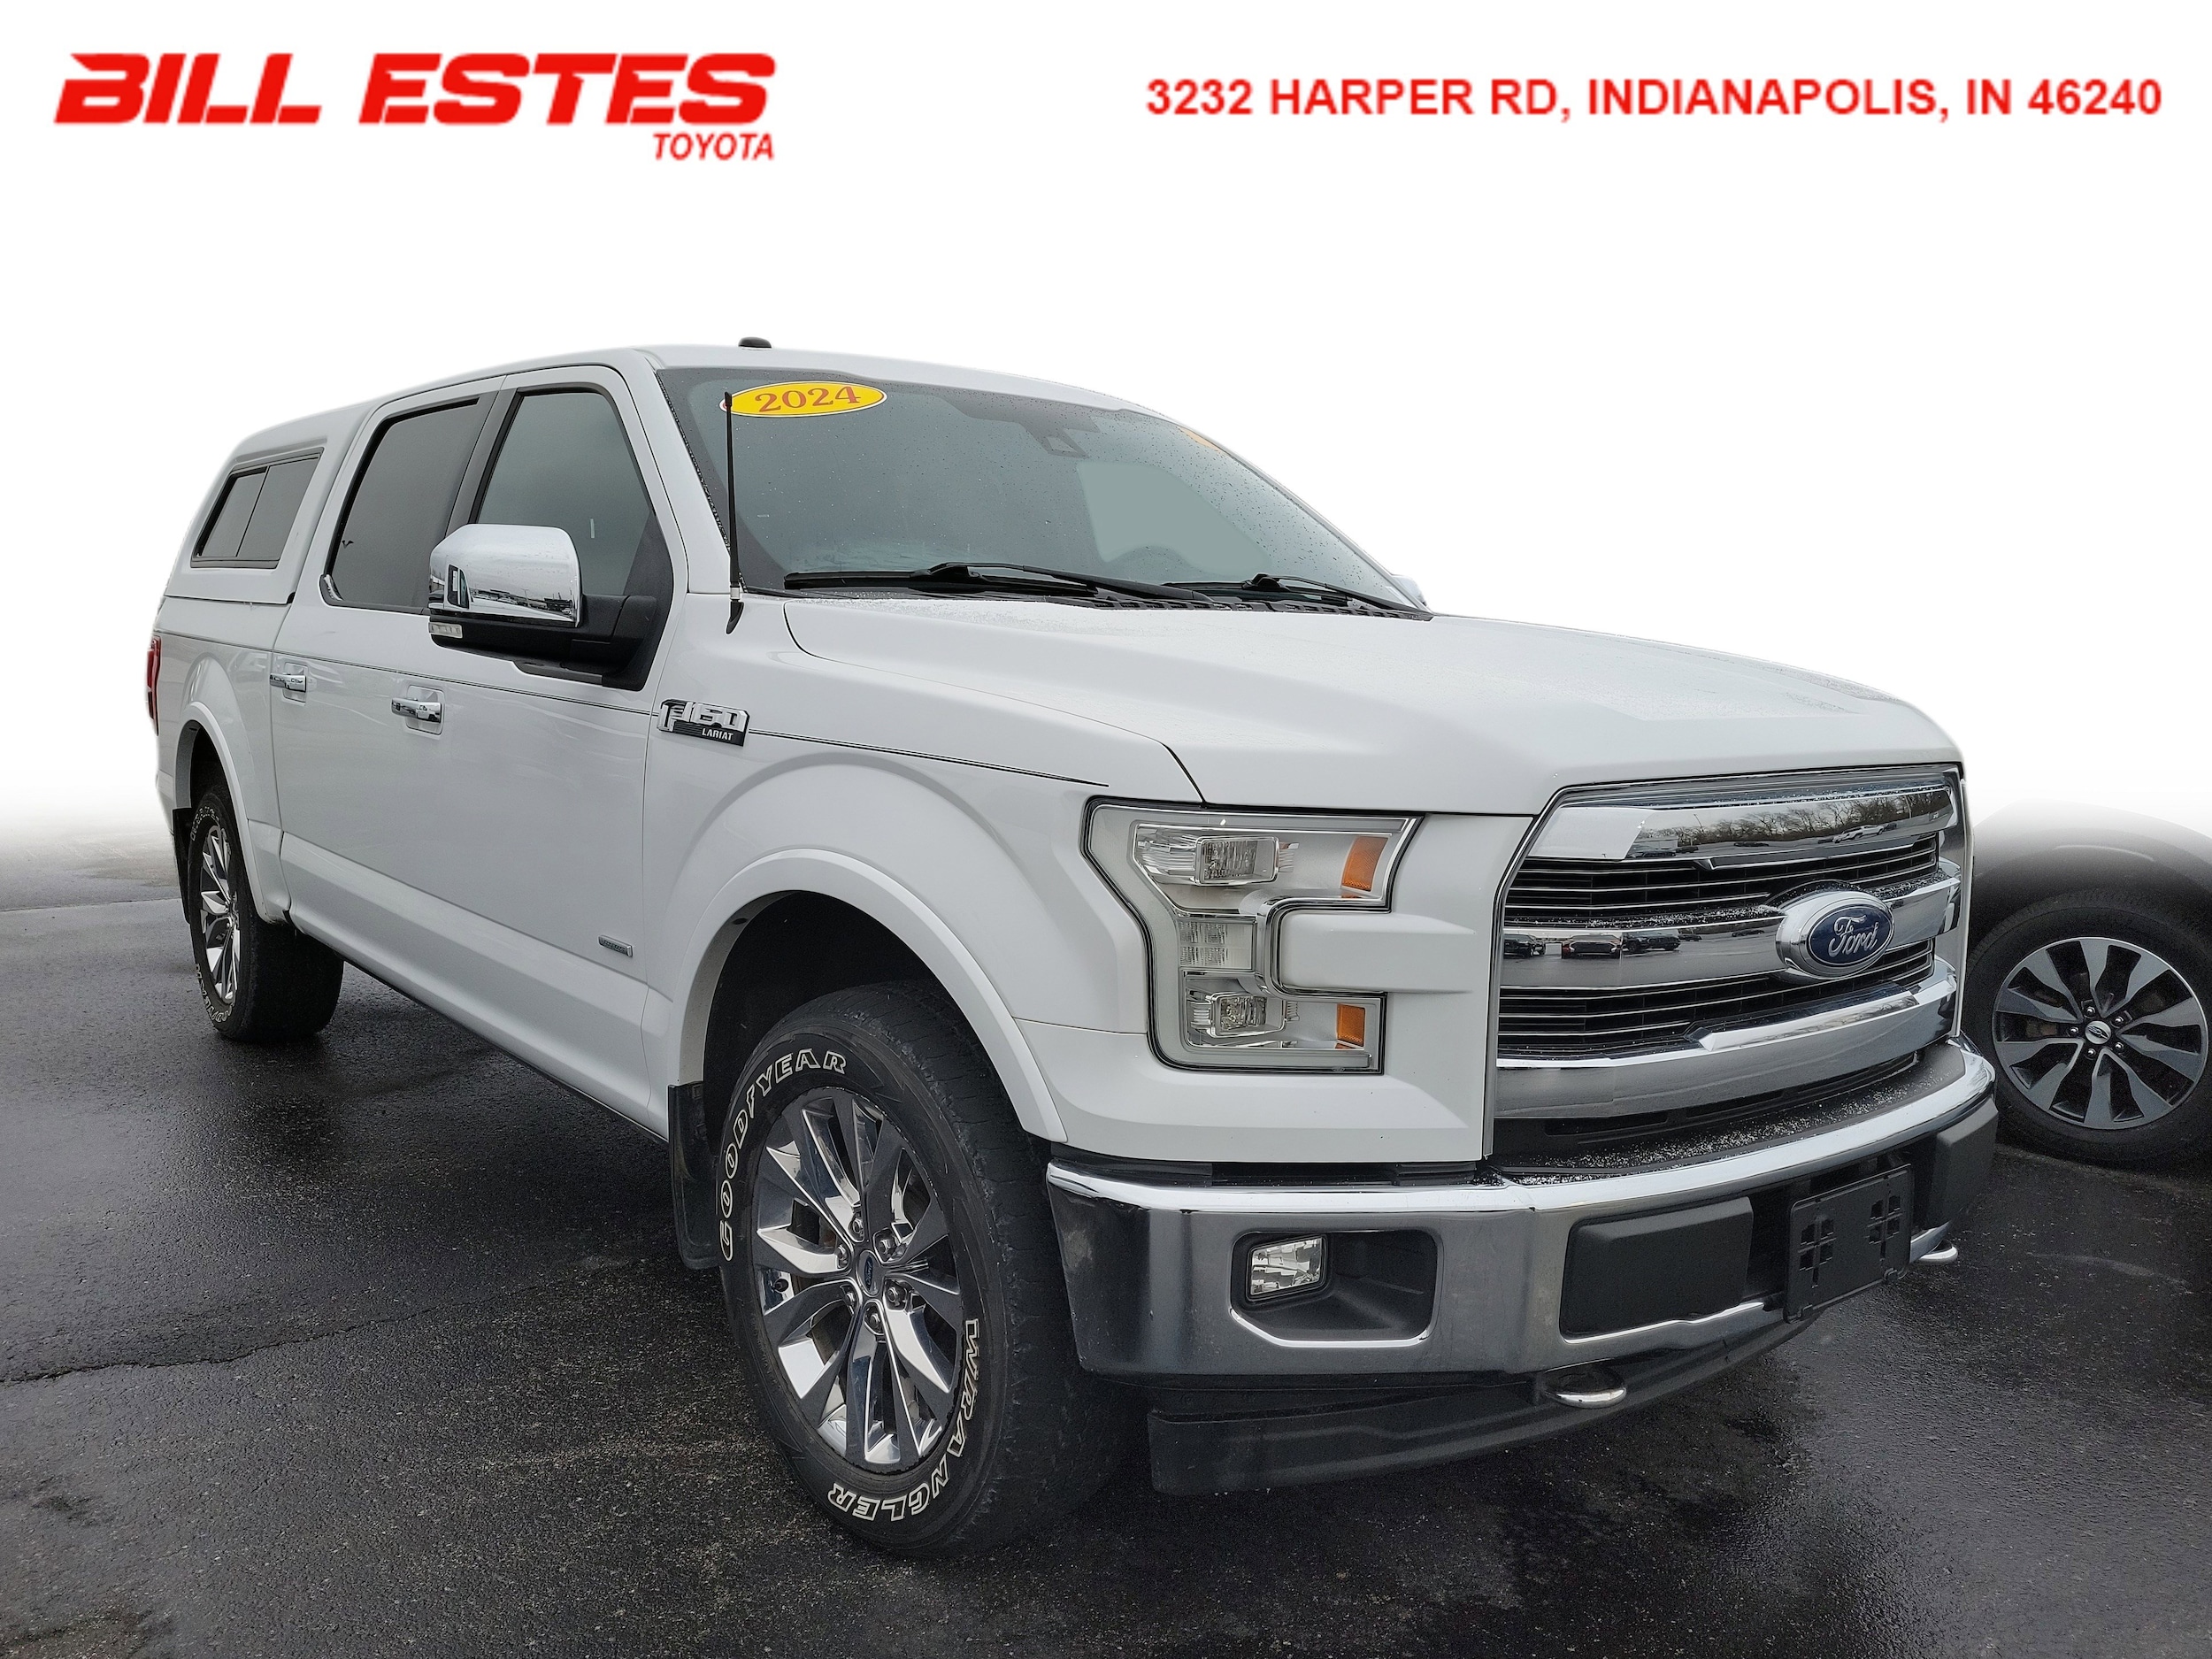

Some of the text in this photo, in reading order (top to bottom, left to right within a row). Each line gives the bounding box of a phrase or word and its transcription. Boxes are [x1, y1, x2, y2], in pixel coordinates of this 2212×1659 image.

[754, 386, 862, 413] 2024
[701, 727, 734, 741] LARIAT
[1828, 914, 1879, 958] Ford
[718, 1048, 847, 1262] GOODYEAR
[826, 1318, 980, 1522] WRANGLER
